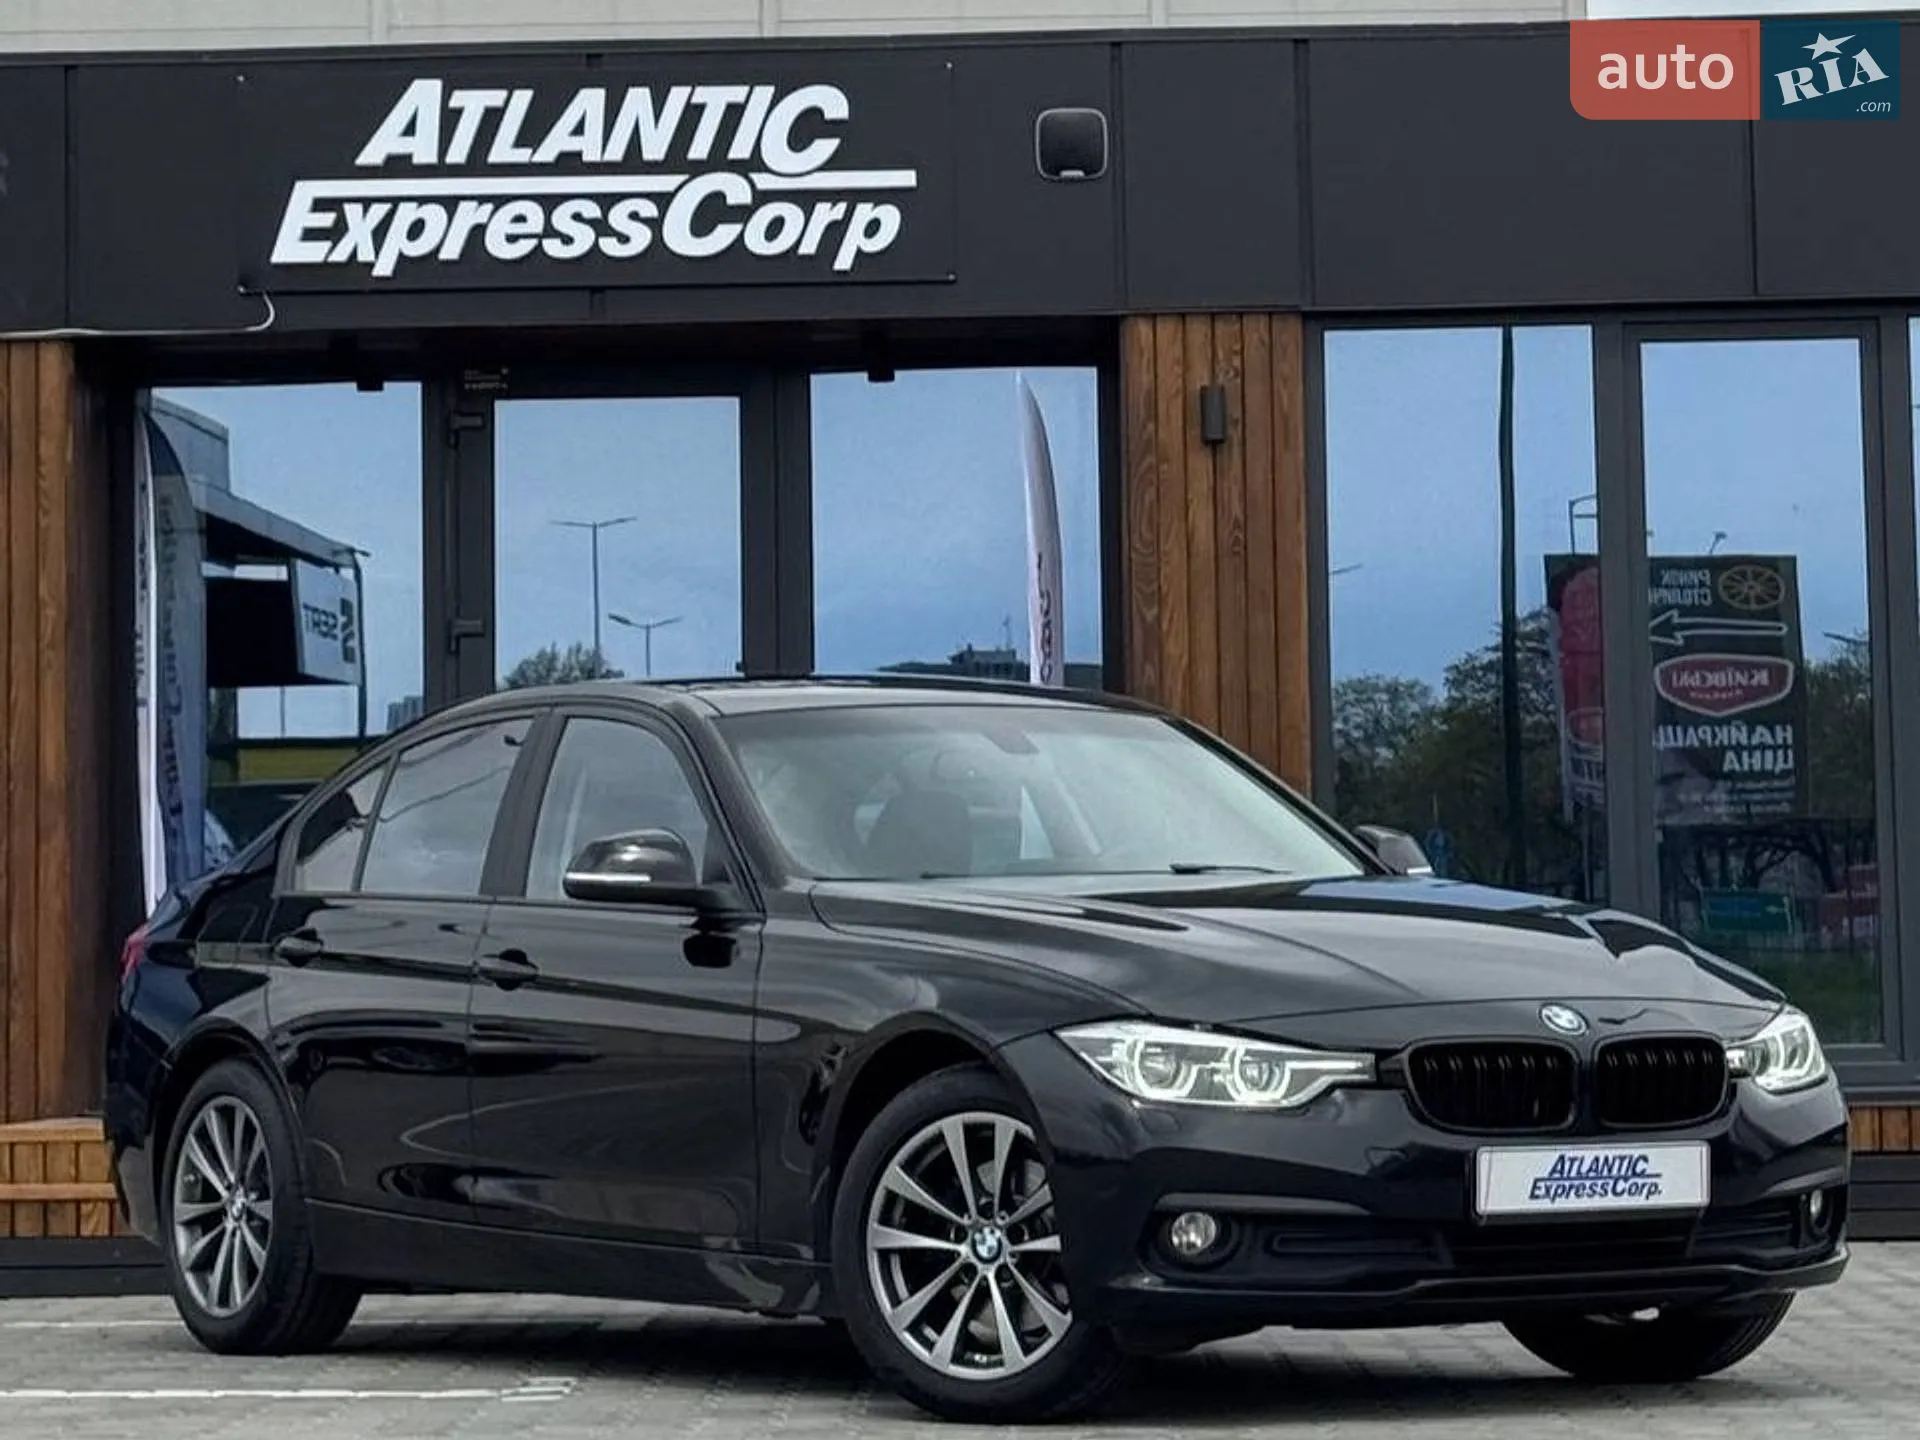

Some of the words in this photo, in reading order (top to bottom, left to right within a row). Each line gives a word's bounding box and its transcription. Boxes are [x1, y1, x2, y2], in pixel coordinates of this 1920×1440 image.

[354, 78, 850, 176] ATLANTIC
[270, 172, 902, 277] ExpressCorp
[1549, 1154, 1649, 1177] ATLANTIC
